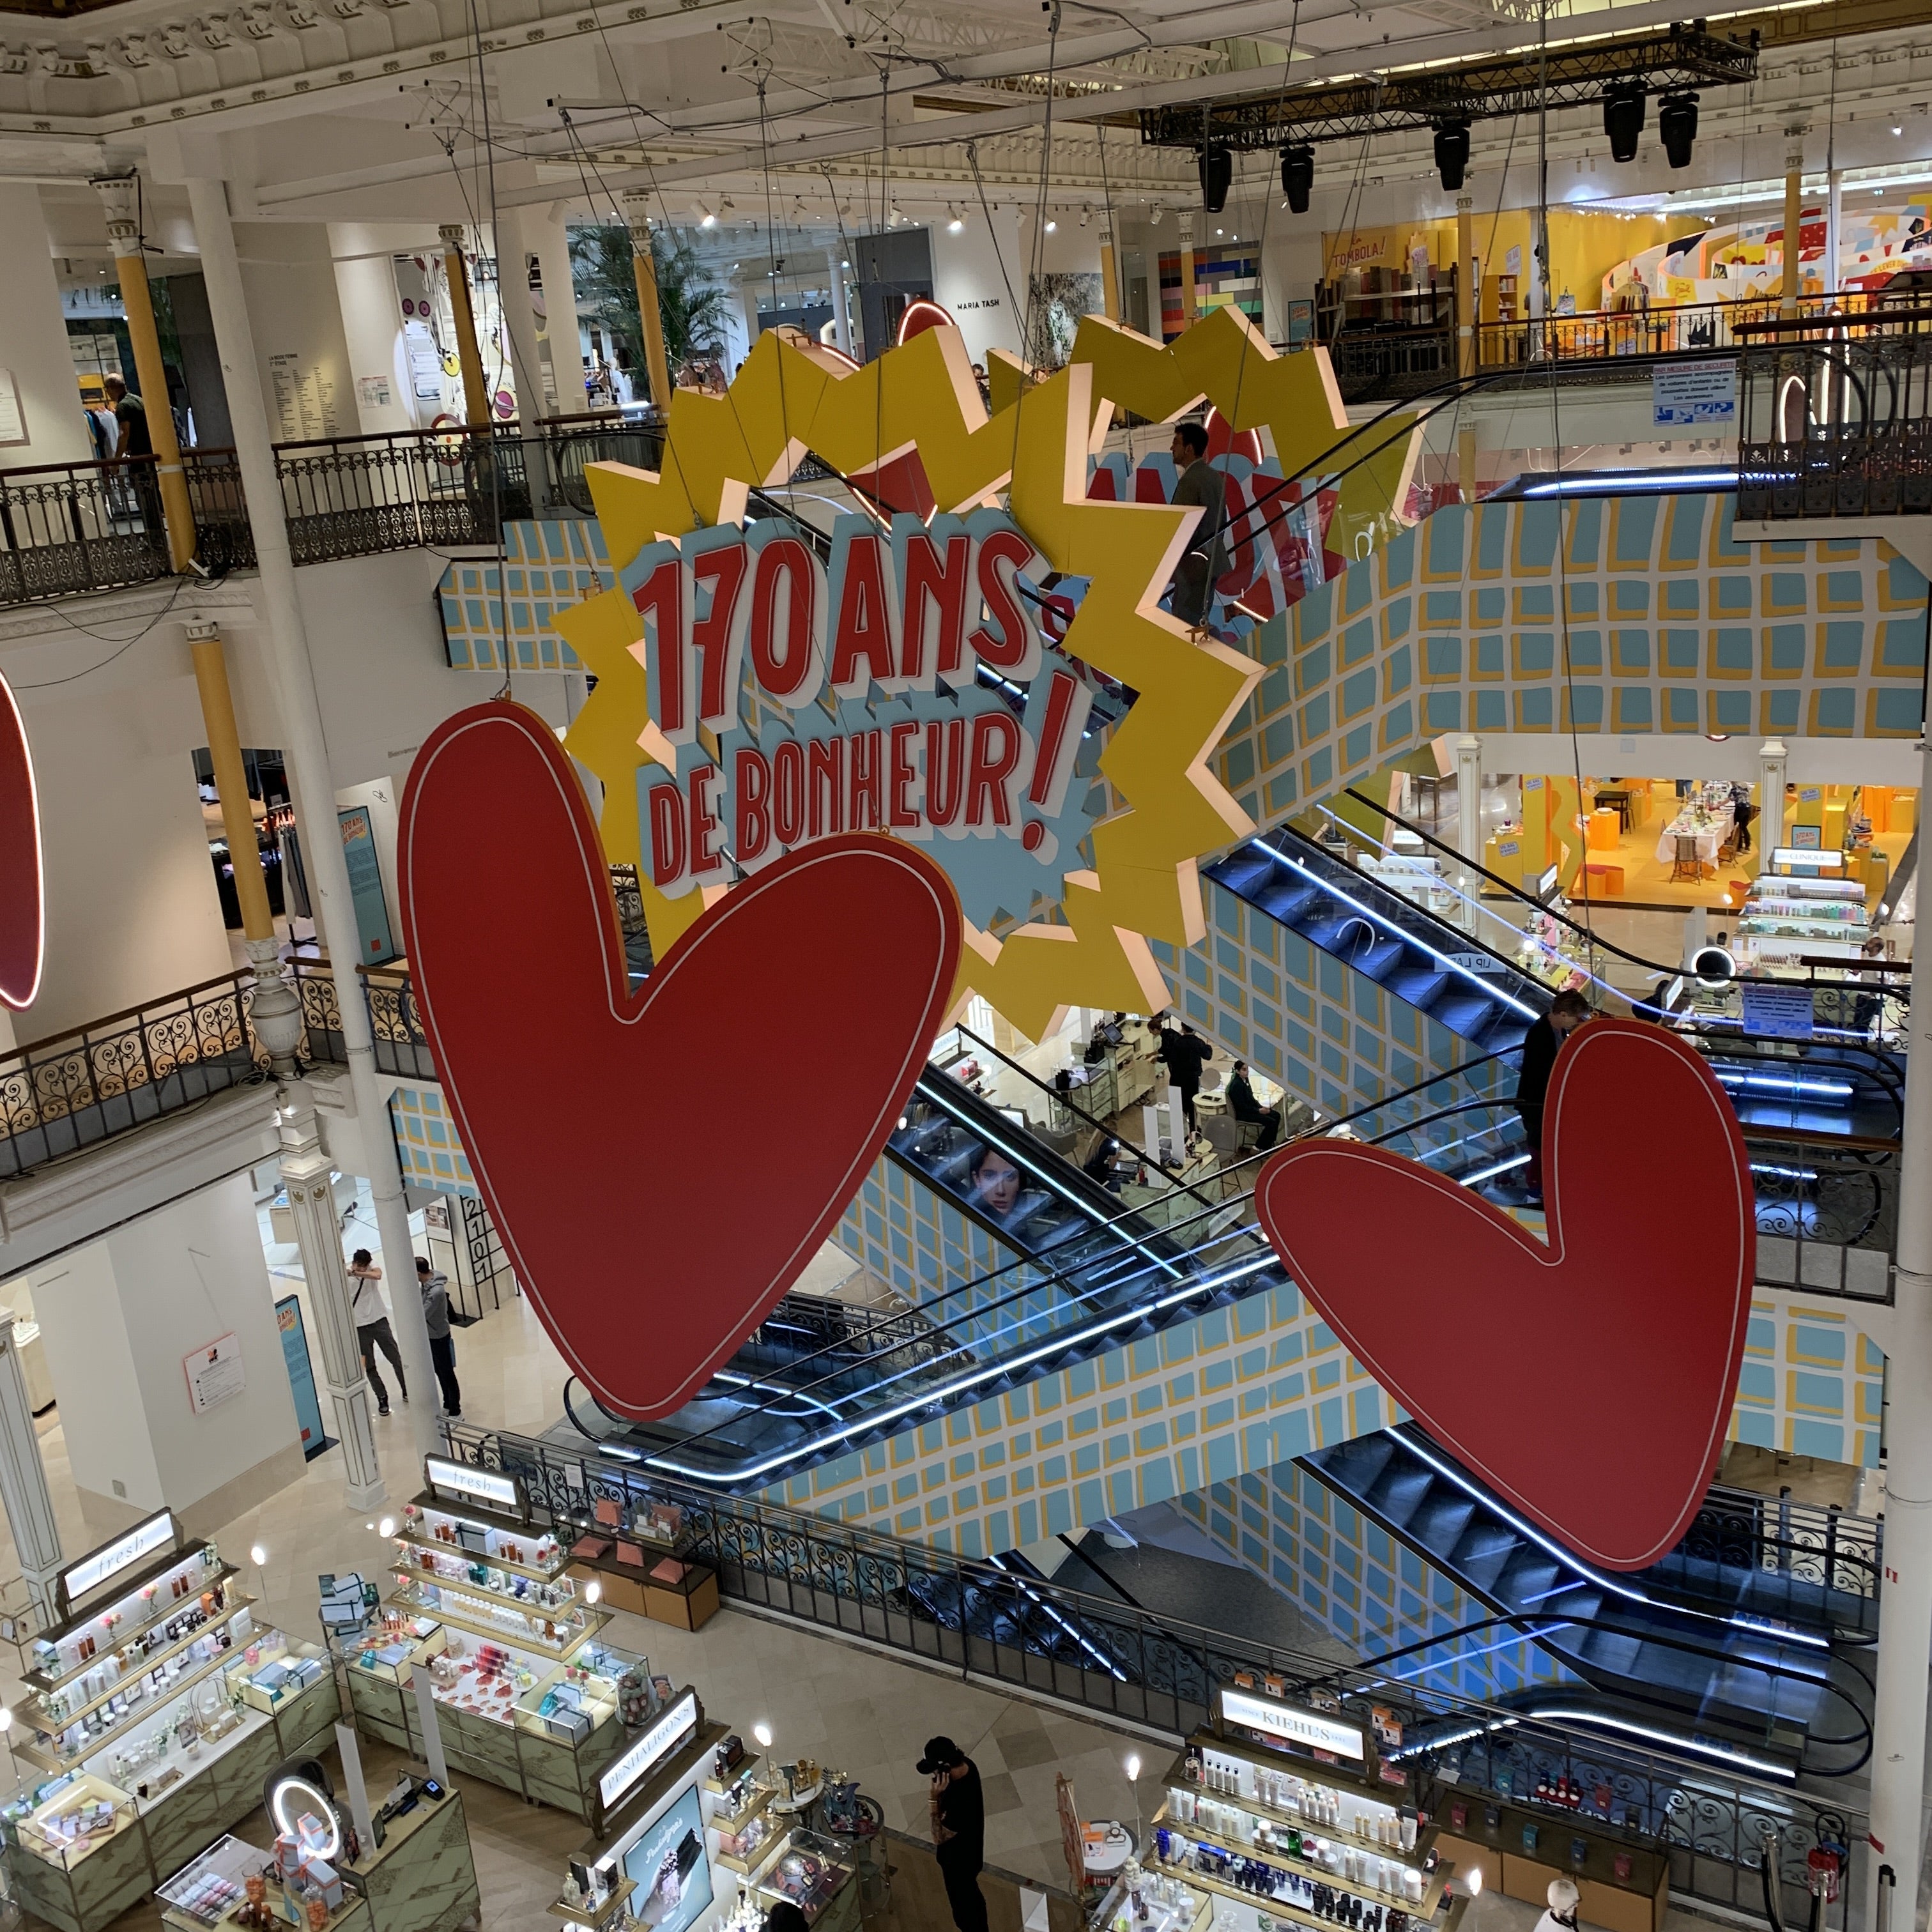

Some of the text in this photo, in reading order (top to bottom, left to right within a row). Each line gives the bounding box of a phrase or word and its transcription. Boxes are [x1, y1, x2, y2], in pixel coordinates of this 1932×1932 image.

[1333, 236, 1386, 268] TOMBOLA!
[957, 298, 999, 310] MARIA TASH
[632, 533, 815, 737] 170
[829, 528, 1037, 688] ANS
[648, 666, 1078, 889] DE BONHEUR!
[1790, 853, 1825, 861] CLINIQUE
[467, 1200, 477, 1219] 2
[472, 1220, 479, 1238] 1
[474, 1242, 484, 1258] 0
[454, 1469, 491, 1491] fresh
[99, 1536, 144, 1579] fresh
[1262, 1710, 1330, 1742] KIEHL'S
[608, 1704, 689, 1790] PENHALIGON'S
